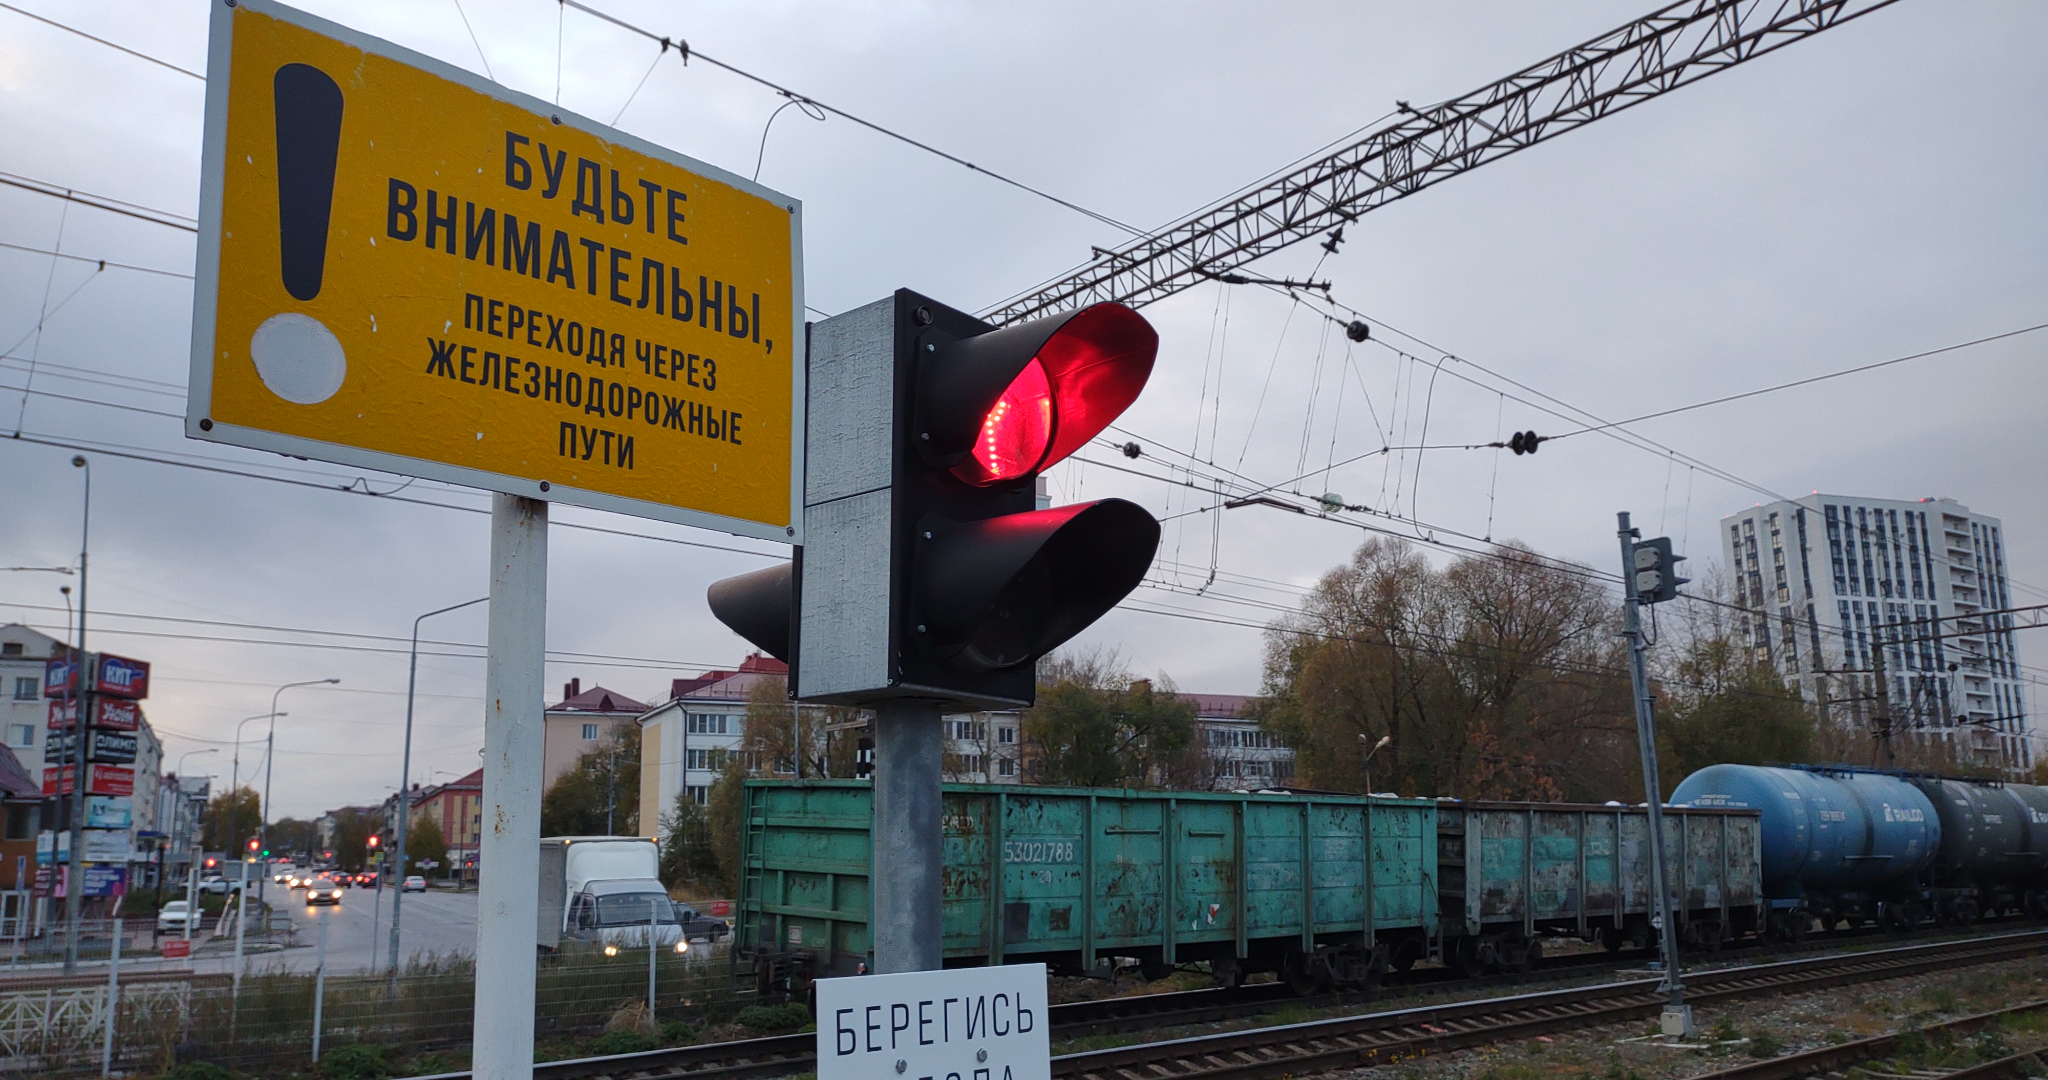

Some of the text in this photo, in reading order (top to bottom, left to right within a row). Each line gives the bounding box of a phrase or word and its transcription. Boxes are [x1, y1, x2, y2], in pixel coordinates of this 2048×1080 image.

[505, 130, 688, 246] БУДЬТЕ
[386, 177, 773, 355] ВНИМАТЕЛЬНЫ,
[425, 336, 743, 446] ЖЕЛЕЗНОДОРОЖНЫЕ
[464, 292, 717, 392] ПЕРЕХОДЯ ЧЕРЕЗ
[559, 420, 634, 471] ПУТИ
[1004, 841, 1074, 863] 53021788
[836, 991, 1034, 1057] БЕРЕГИСЬ
